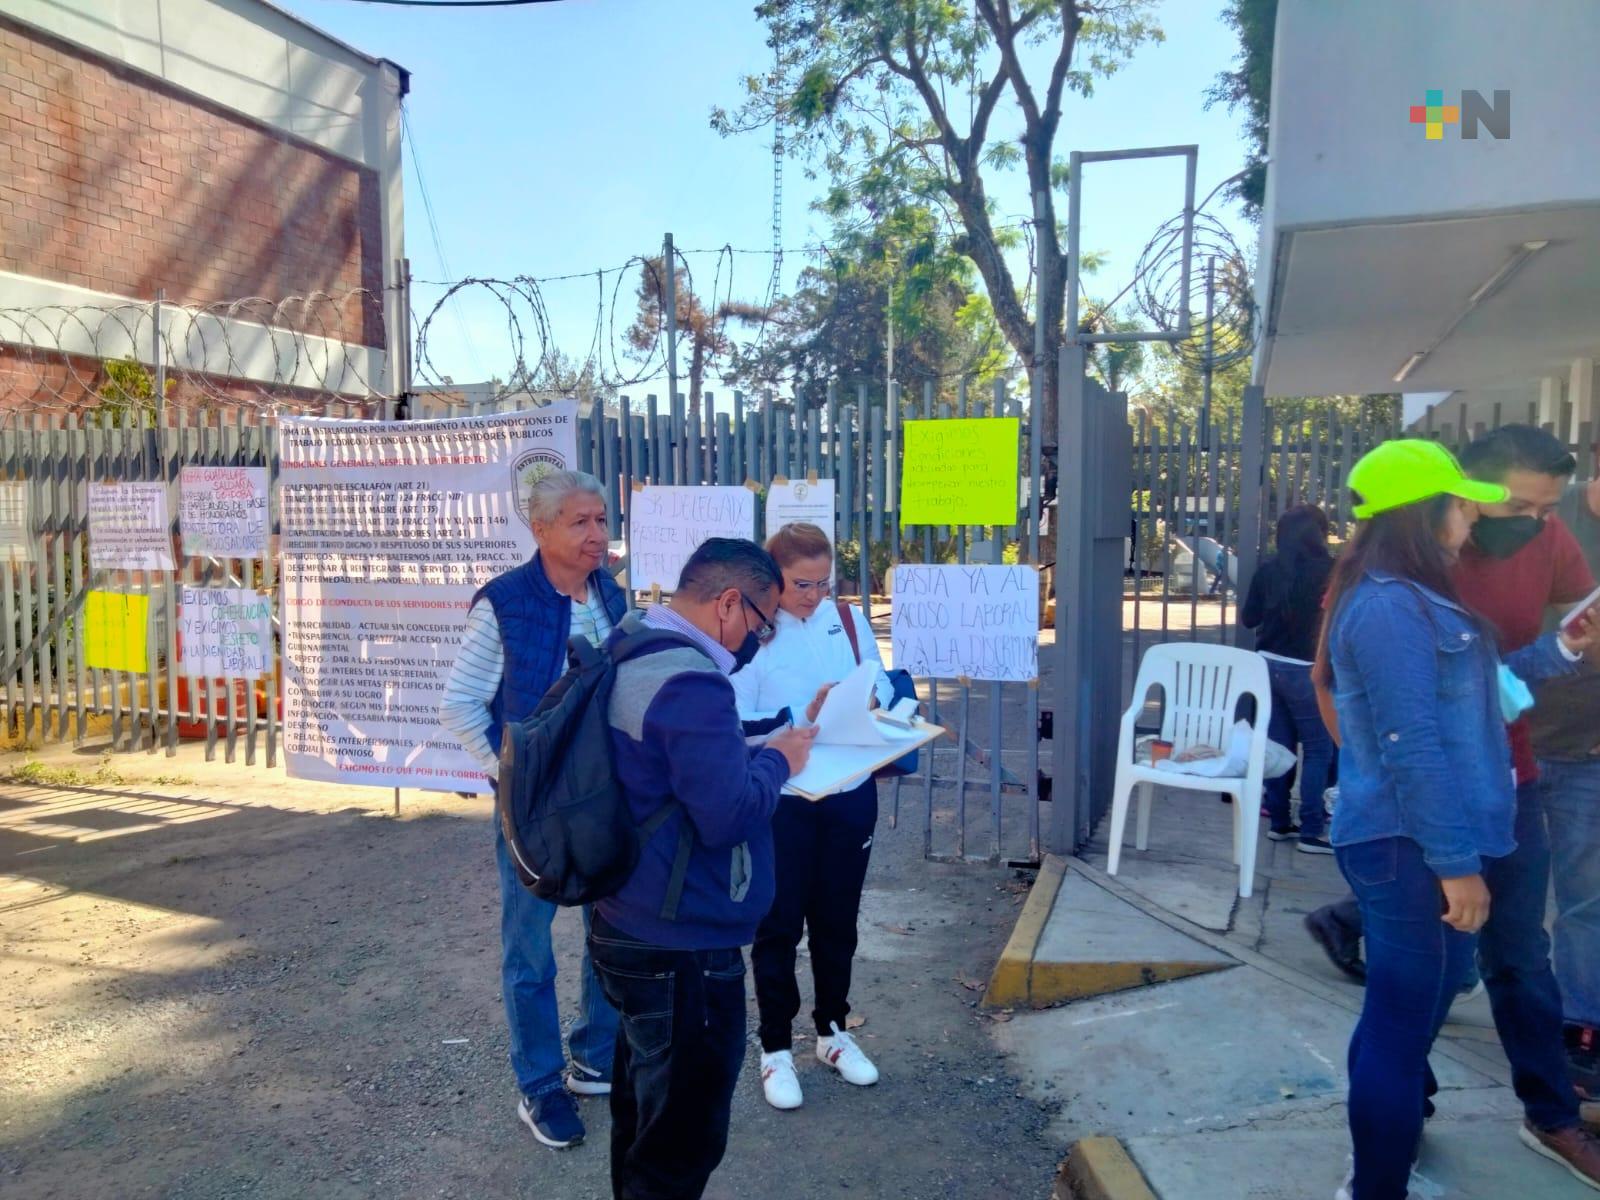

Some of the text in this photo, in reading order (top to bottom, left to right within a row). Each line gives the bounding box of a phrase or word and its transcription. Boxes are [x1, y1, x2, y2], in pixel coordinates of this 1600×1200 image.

[370, 424, 387, 433] POR
[388, 422, 458, 432] INCUMPLIMIENTO
[461, 421, 467, 430] A
[469, 420, 485, 429] LAS
[487, 417, 552, 428] CONDICIONES
[555, 415, 569, 424] DE
[422, 435, 433, 444] DE
[436, 434, 451, 443] LOS
[454, 431, 507, 442] SERVIDORES
[334, 483, 345, 491] DE
[370, 505, 397, 514] MADRE
[344, 529, 355, 538] DE
[356, 529, 370, 538] LOS
[346, 541, 373, 549] DIGNO
[380, 540, 430, 550] RESPETUOSO
[432, 540, 443, 549] DE
[446, 540, 462, 549] SUS
[463, 540, 517, 550] SUPERIORES
[376, 553, 430, 561] SUBALTERNOS
[408, 565, 418, 573] AL
[463, 565, 474, 574] LA
[895, 567, 1032, 598] BASTA YA AL
[328, 599, 373, 608] CONDUCTA
[374, 599, 385, 608] DE
[387, 600, 401, 609] LOS
[403, 600, 452, 609] SERVIDORES
[895, 602, 950, 630] ACOSO
[359, 622, 450, 633] ACTUAR SIN CONCEDER
[410, 635, 441, 644] ACCESO
[443, 636, 450, 644] A
[452, 636, 462, 646] LA
[897, 638, 907, 662] Y
[914, 637, 930, 665] A
[934, 637, 960, 665] LA
[333, 655, 349, 664] DAR
[417, 658, 429, 667] UN
[365, 668, 376, 676] DE
[378, 669, 388, 677] LA
[962, 664, 1013, 680] BASTA
[340, 679, 355, 687] LAS
[356, 680, 382, 688] METAS
[342, 689, 352, 698] SU
[354, 690, 383, 699] LOGRO
[368, 702, 382, 711] MIS
[387, 715, 408, 725] PARA
